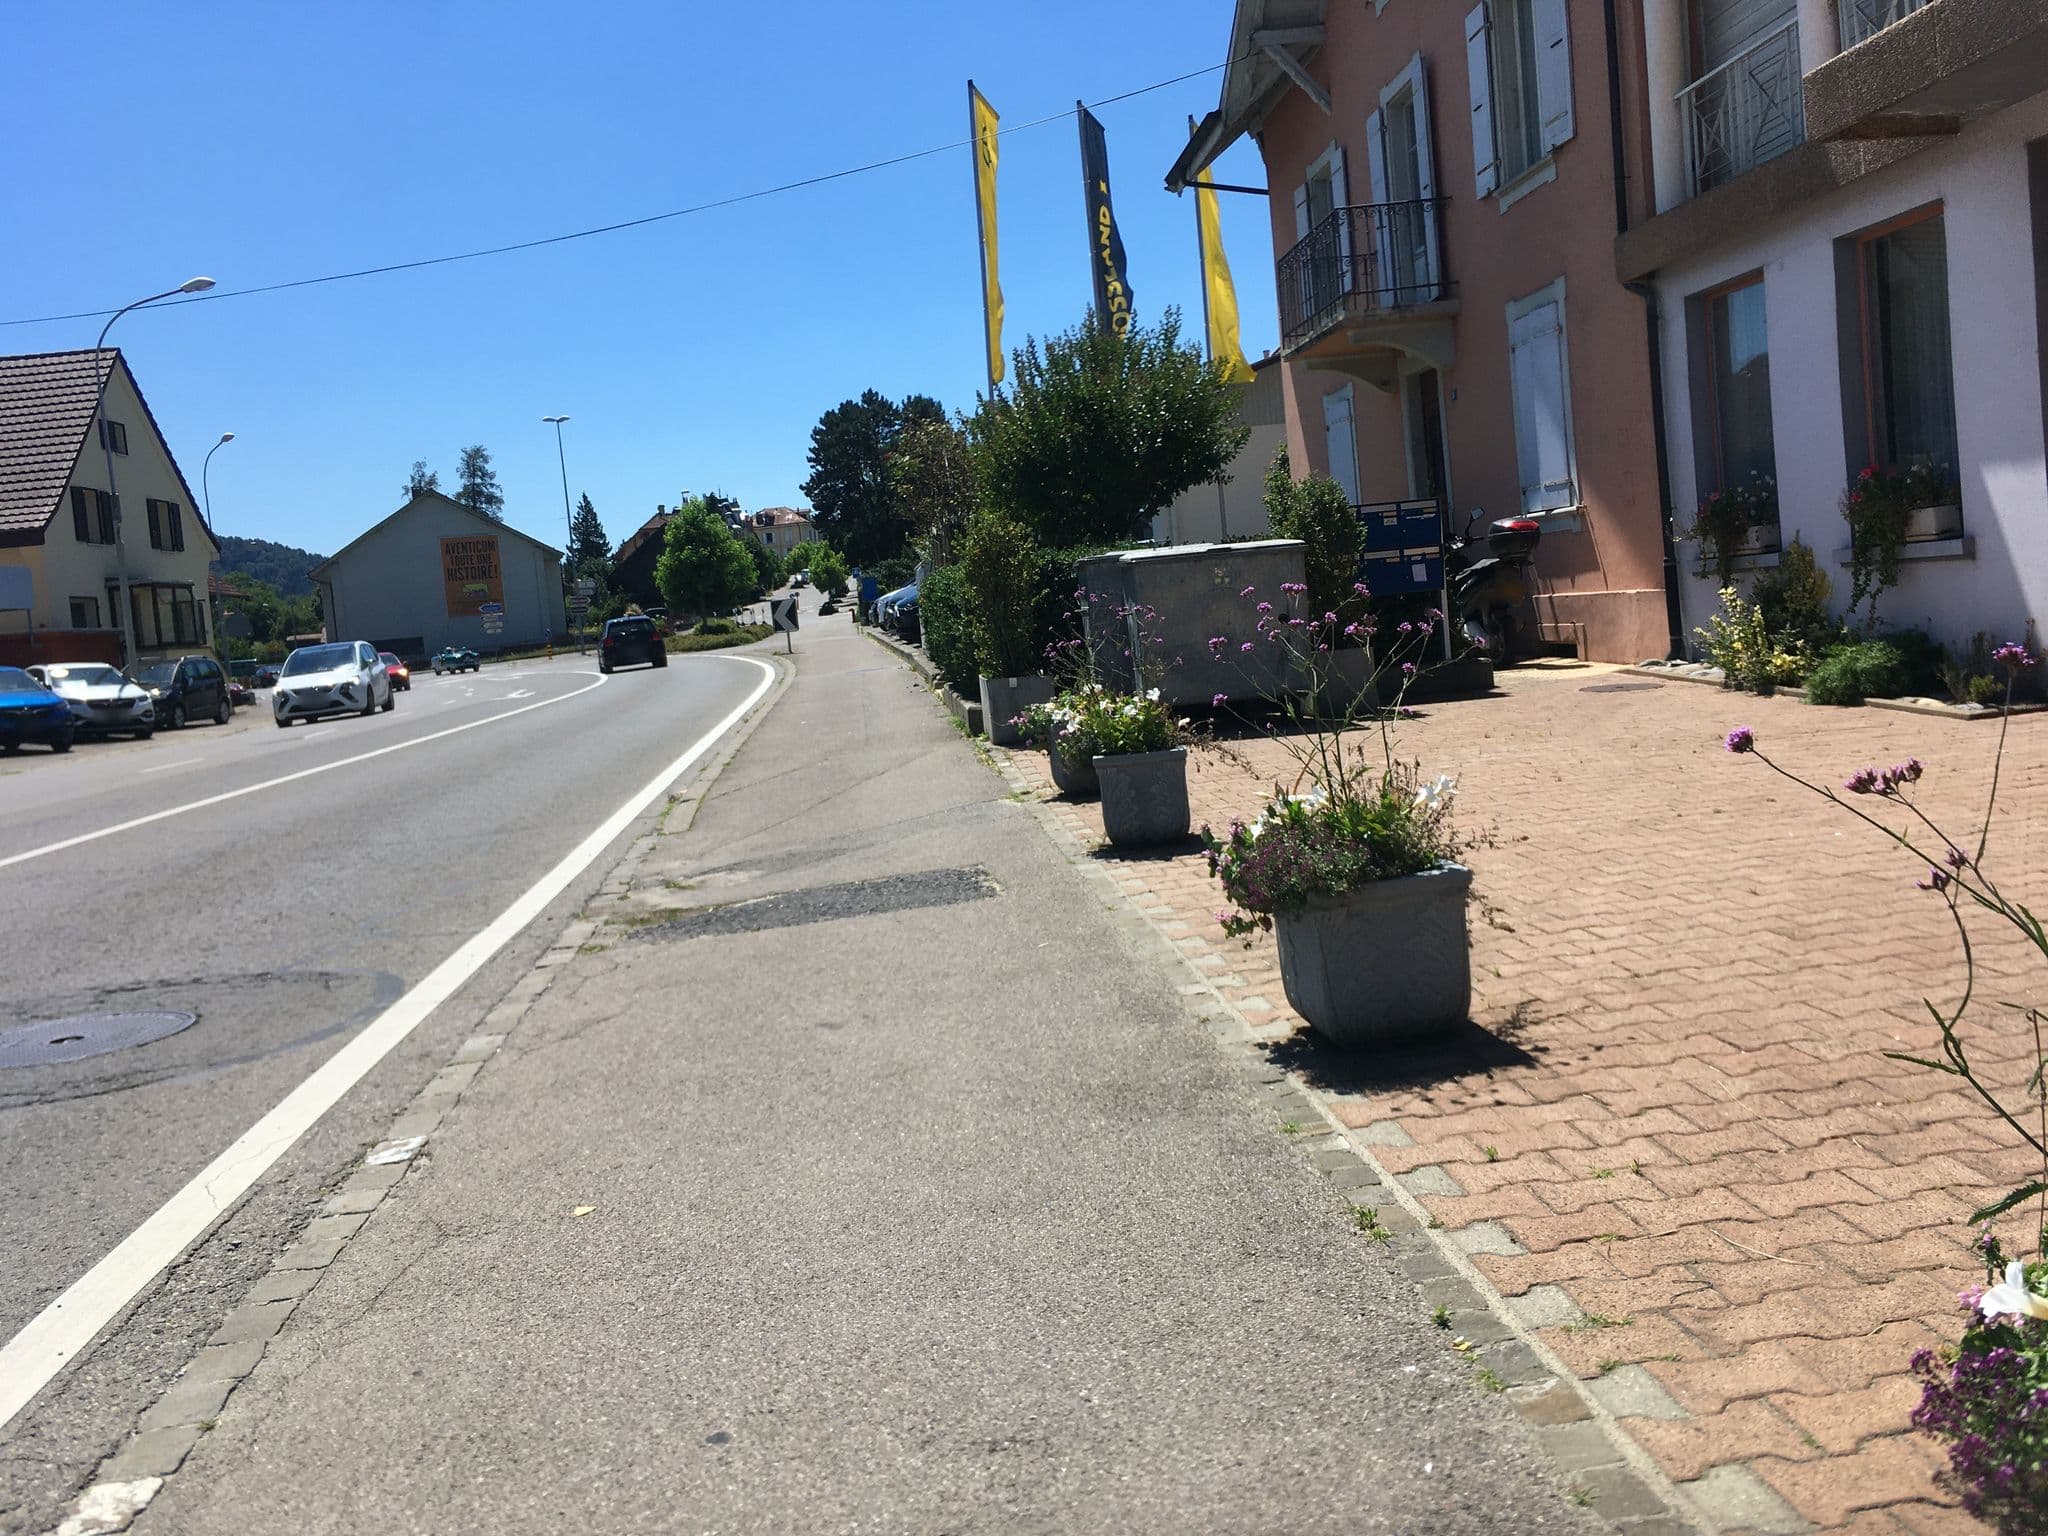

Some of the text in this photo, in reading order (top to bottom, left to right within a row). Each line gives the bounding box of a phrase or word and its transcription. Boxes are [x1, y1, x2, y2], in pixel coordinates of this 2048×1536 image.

[450, 553, 493, 567] TOUTE UNE
[446, 565, 498, 582] HISTOIRE!
